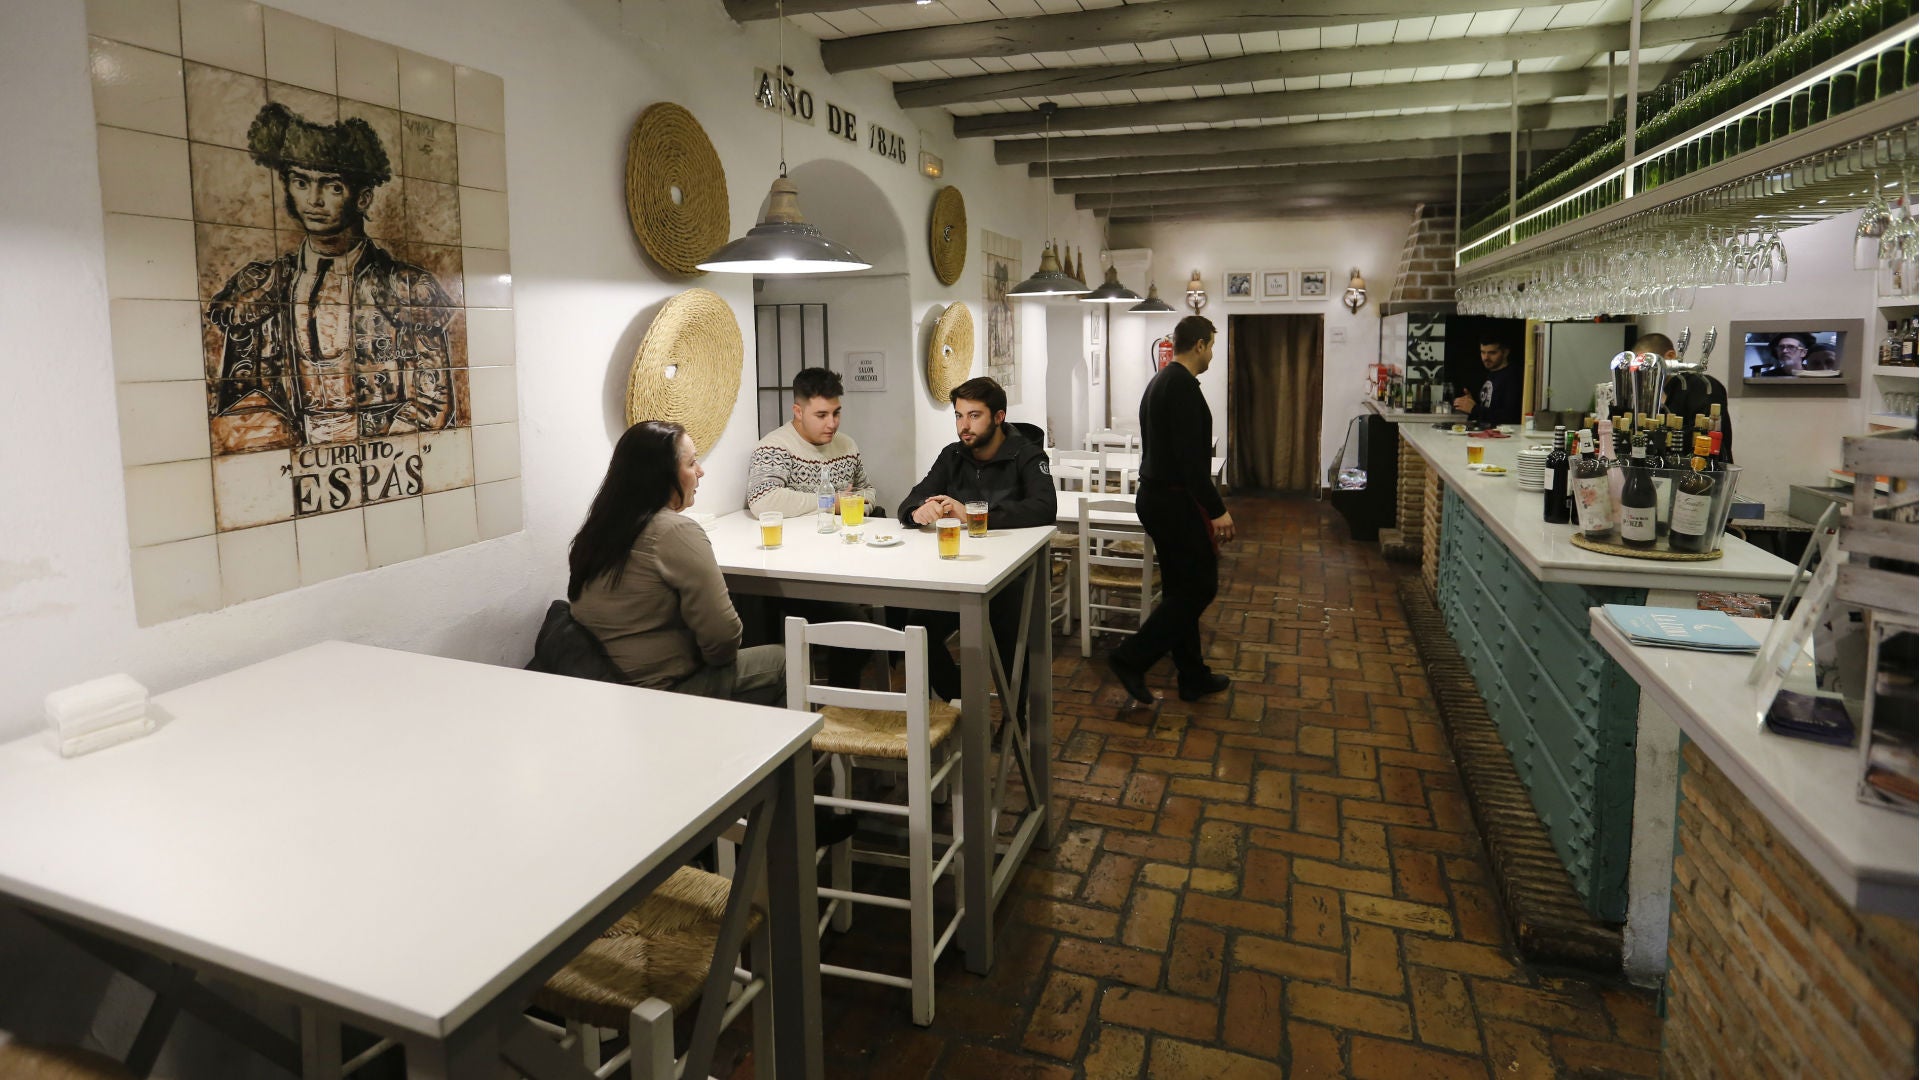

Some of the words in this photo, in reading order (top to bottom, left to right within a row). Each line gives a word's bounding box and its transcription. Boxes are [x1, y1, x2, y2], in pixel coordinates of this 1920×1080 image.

[756, 65, 814, 120] AÑO
[828, 103, 858, 142] DE
[869, 125, 907, 164] 1846
[299, 440, 394, 468] CURRITO
